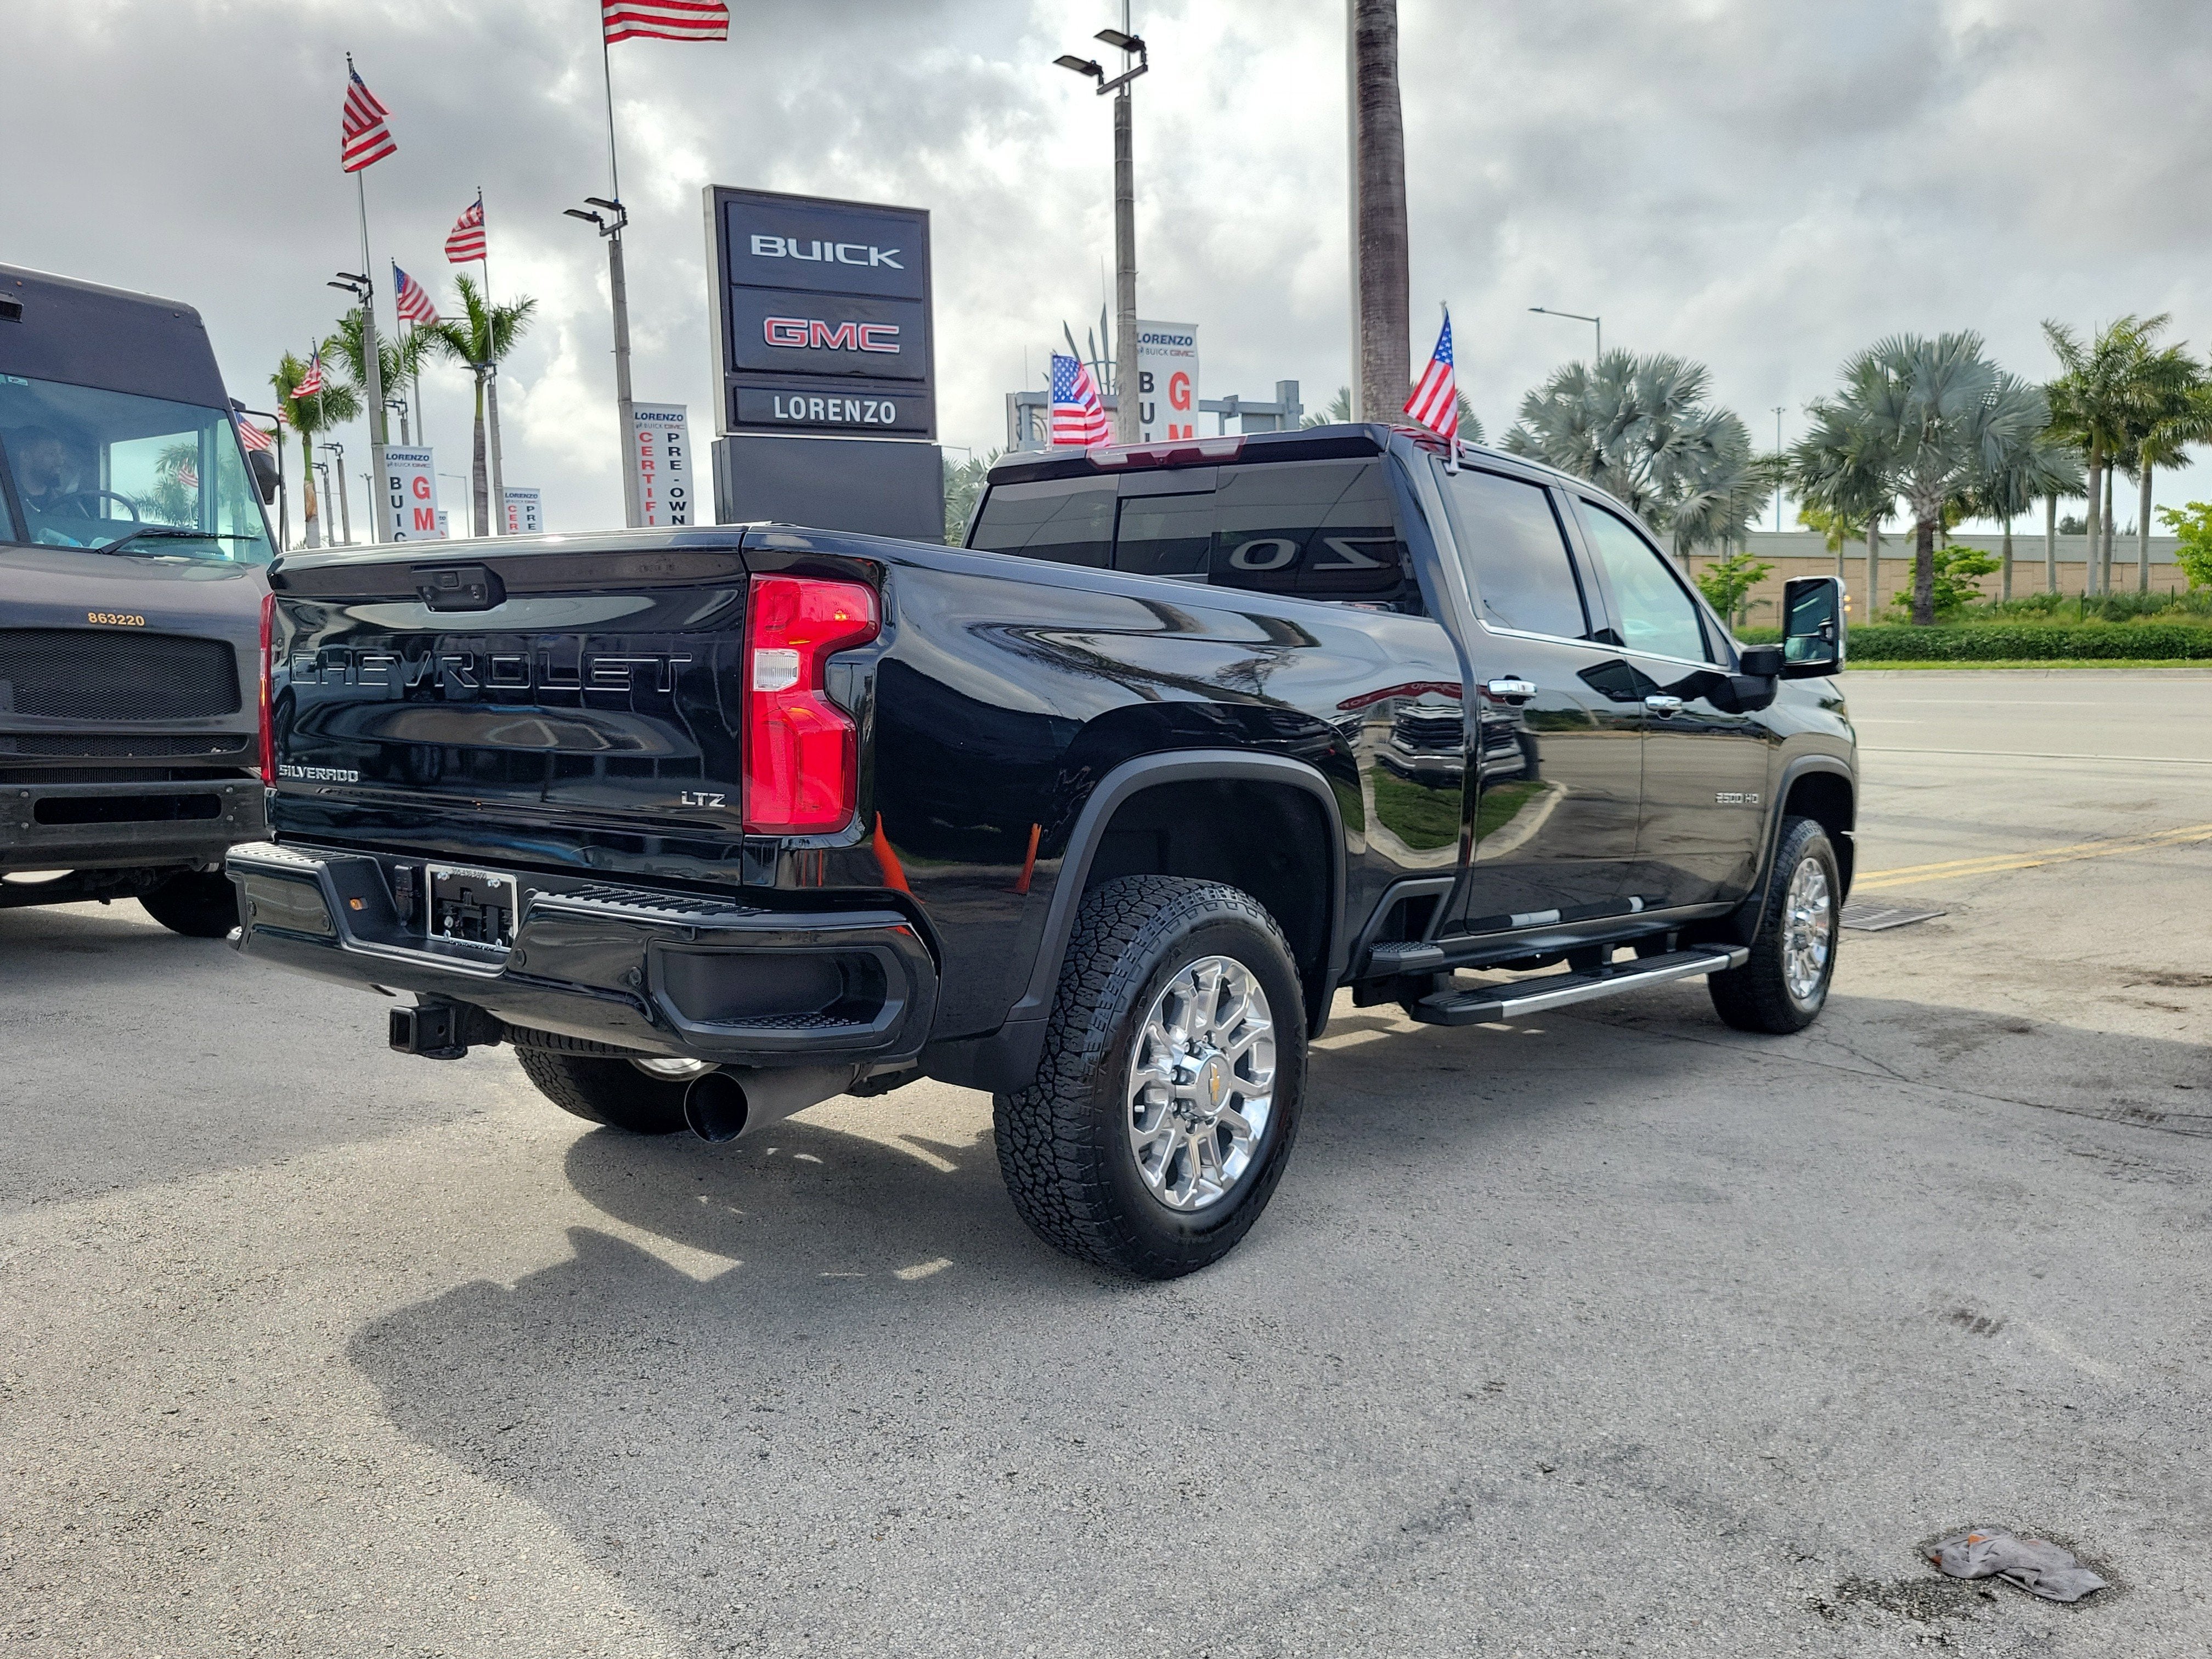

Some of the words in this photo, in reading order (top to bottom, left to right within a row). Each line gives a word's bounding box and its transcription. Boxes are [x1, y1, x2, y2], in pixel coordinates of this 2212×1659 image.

[751, 234, 905, 269] BUICK
[764, 317, 900, 353] GMC
[635, 412, 684, 421] LORENZO
[774, 396, 896, 424] LORENZO
[386, 453, 430, 461] LORENZO
[87, 612, 146, 627] 863220
[290, 650, 692, 692] CHEVROLET
[279, 764, 359, 783] SILVERADO
[681, 791, 726, 808] LTZ
